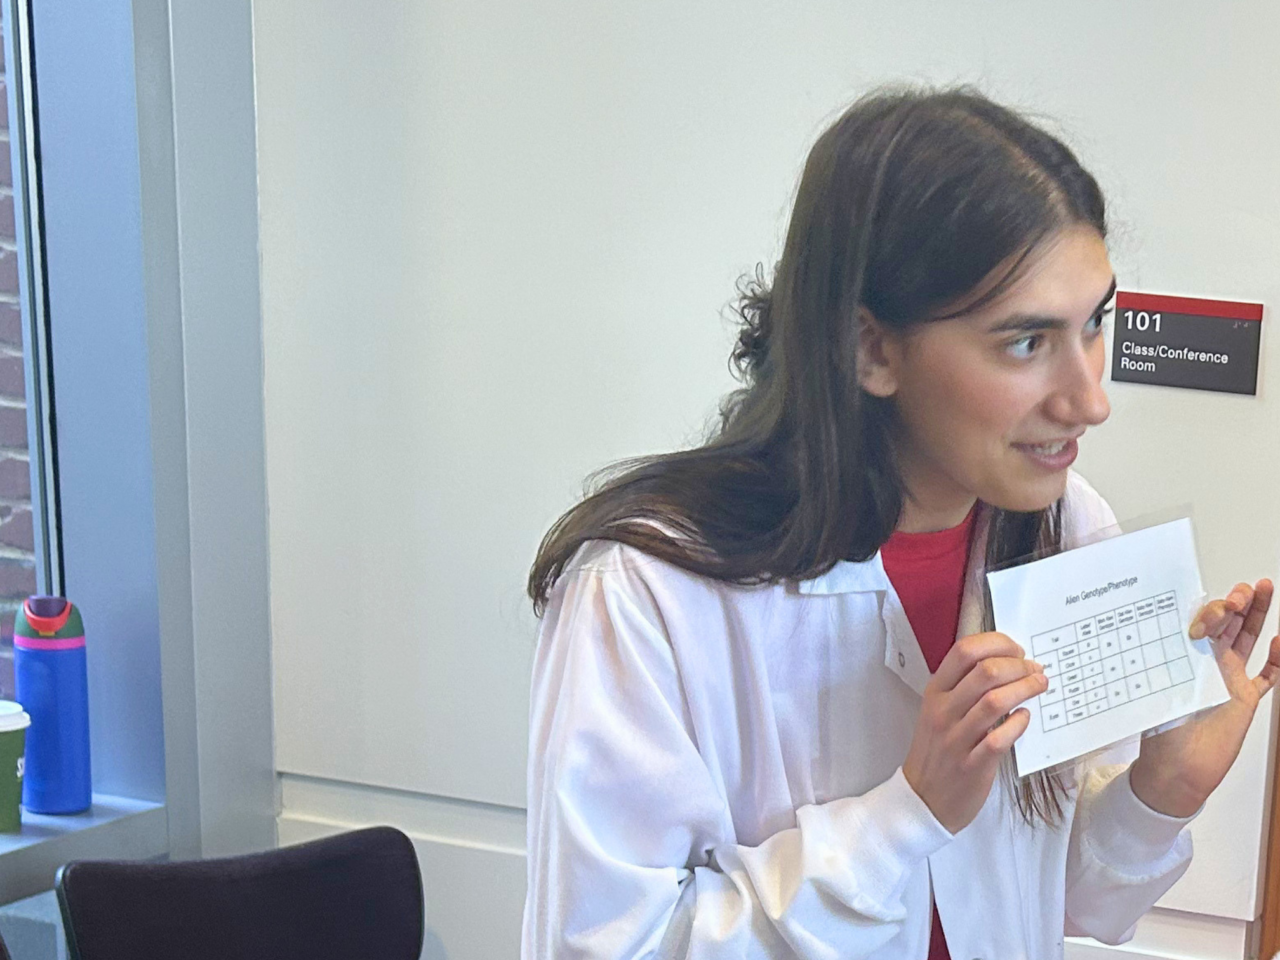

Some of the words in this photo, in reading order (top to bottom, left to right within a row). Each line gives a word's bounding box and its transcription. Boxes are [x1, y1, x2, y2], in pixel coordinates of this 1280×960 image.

[1124, 310, 1162, 332] 101
[1122, 341, 1228, 364] Class/Conference
[1120, 357, 1156, 372] Room
[1065, 594, 1080, 606] Alien
[1080, 576, 1138, 600] Genotype/Phenotype
